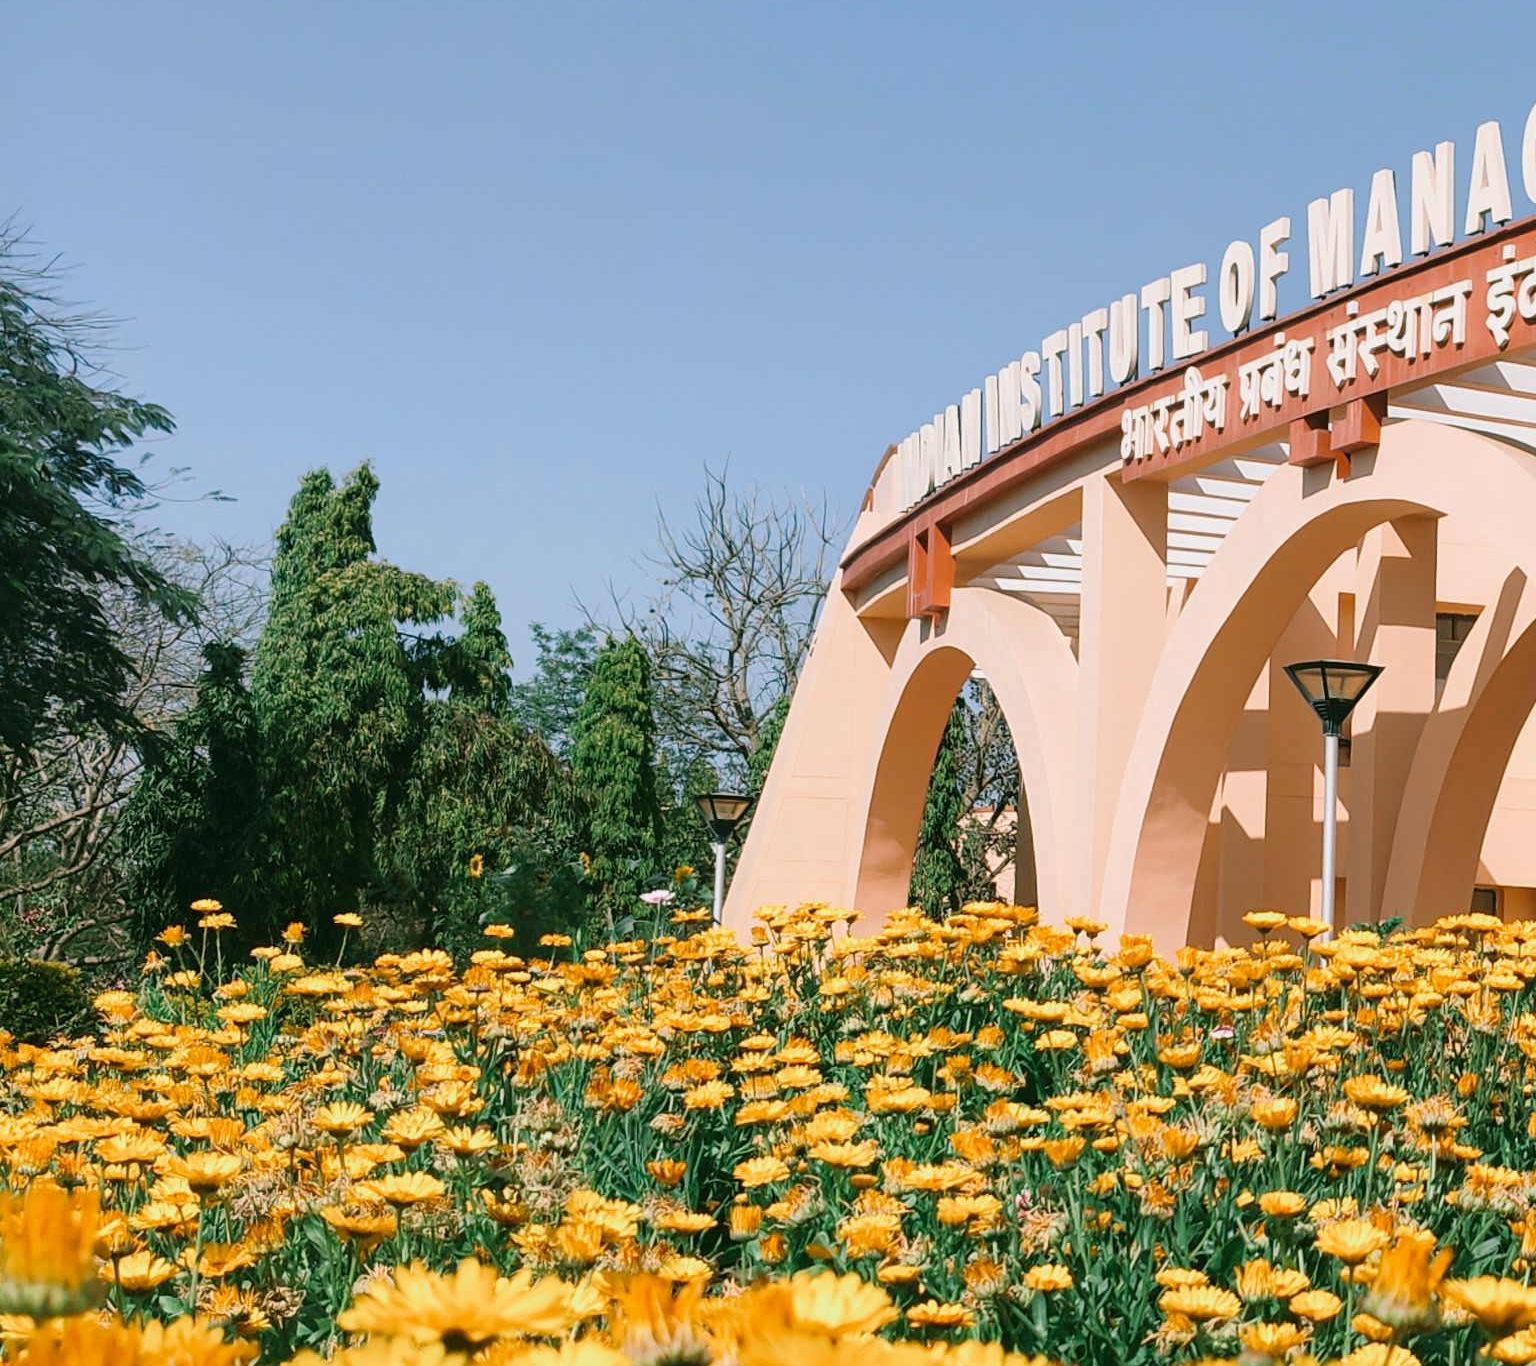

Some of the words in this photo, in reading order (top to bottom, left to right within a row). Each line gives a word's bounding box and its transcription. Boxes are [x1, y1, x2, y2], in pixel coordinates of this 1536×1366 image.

[898, 388, 982, 513] INDIAN
[985, 262, 1209, 454] INSTITUTE
[1219, 216, 1291, 333] OF
[1120, 366, 1228, 460] भारतीय
[1238, 332, 1315, 420] प्रबंध
[1325, 301, 1473, 387] संस्थान
